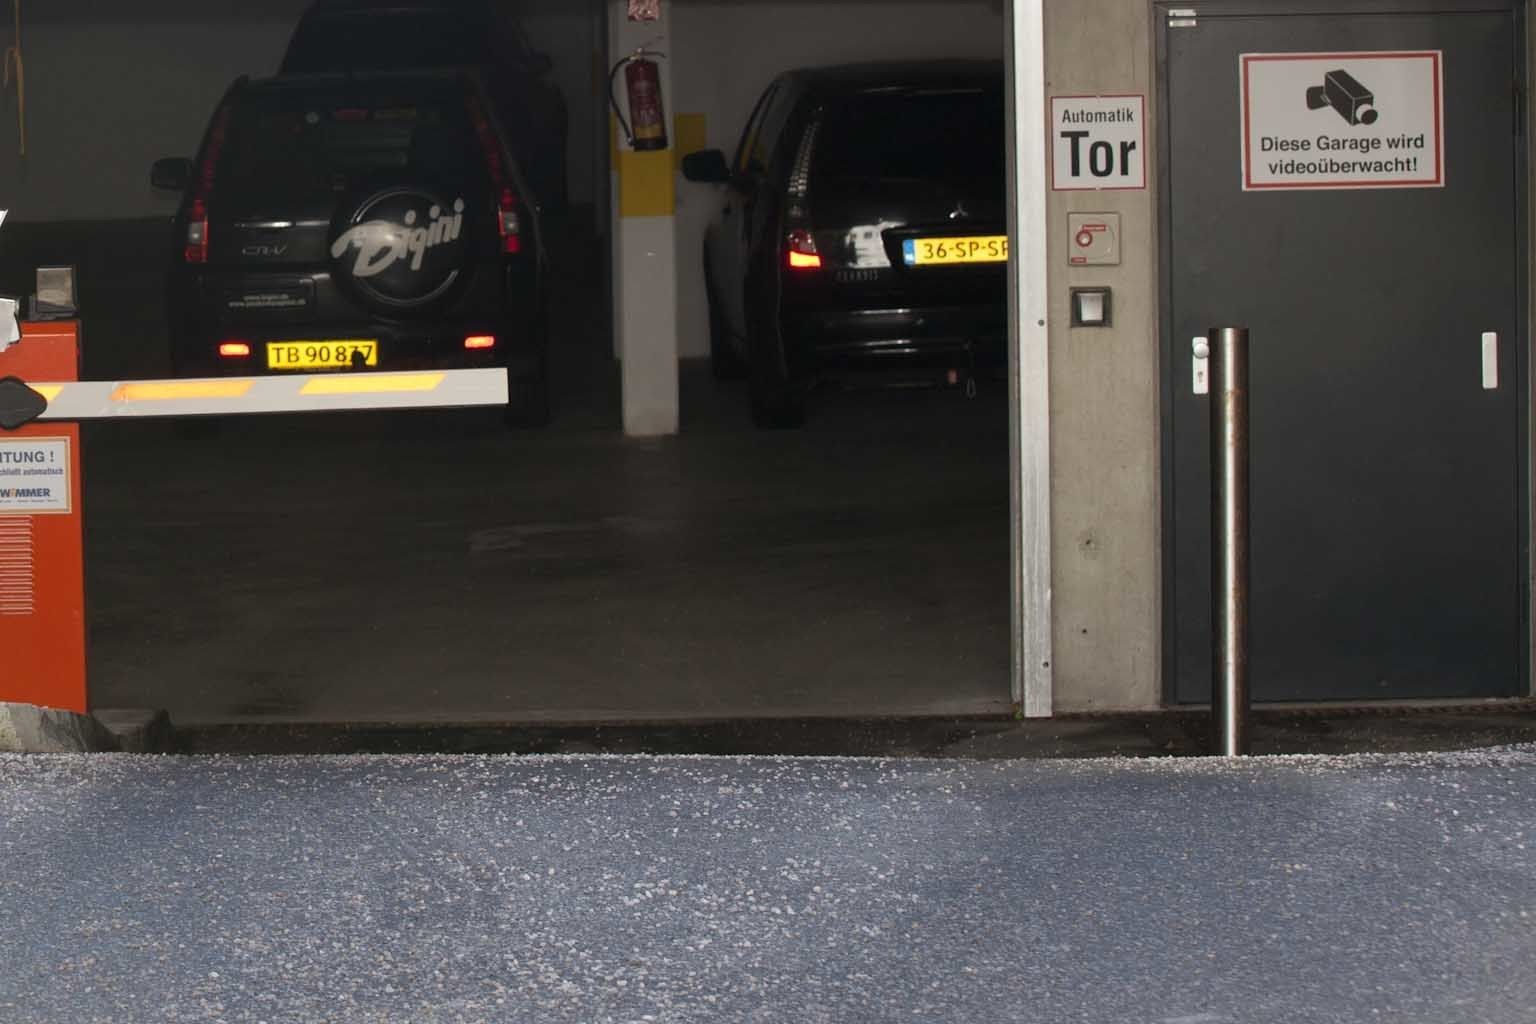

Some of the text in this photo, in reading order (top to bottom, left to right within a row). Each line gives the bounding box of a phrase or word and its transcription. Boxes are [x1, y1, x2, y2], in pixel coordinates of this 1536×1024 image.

[1062, 107, 1134, 123] Automatik
[1261, 133, 1425, 154] Diese Garage wird
[1060, 130, 1136, 178] Tor
[1268, 157, 1417, 175] videoüberwacht!
[272, 346, 299, 364] TB
[305, 345, 331, 363] 90
